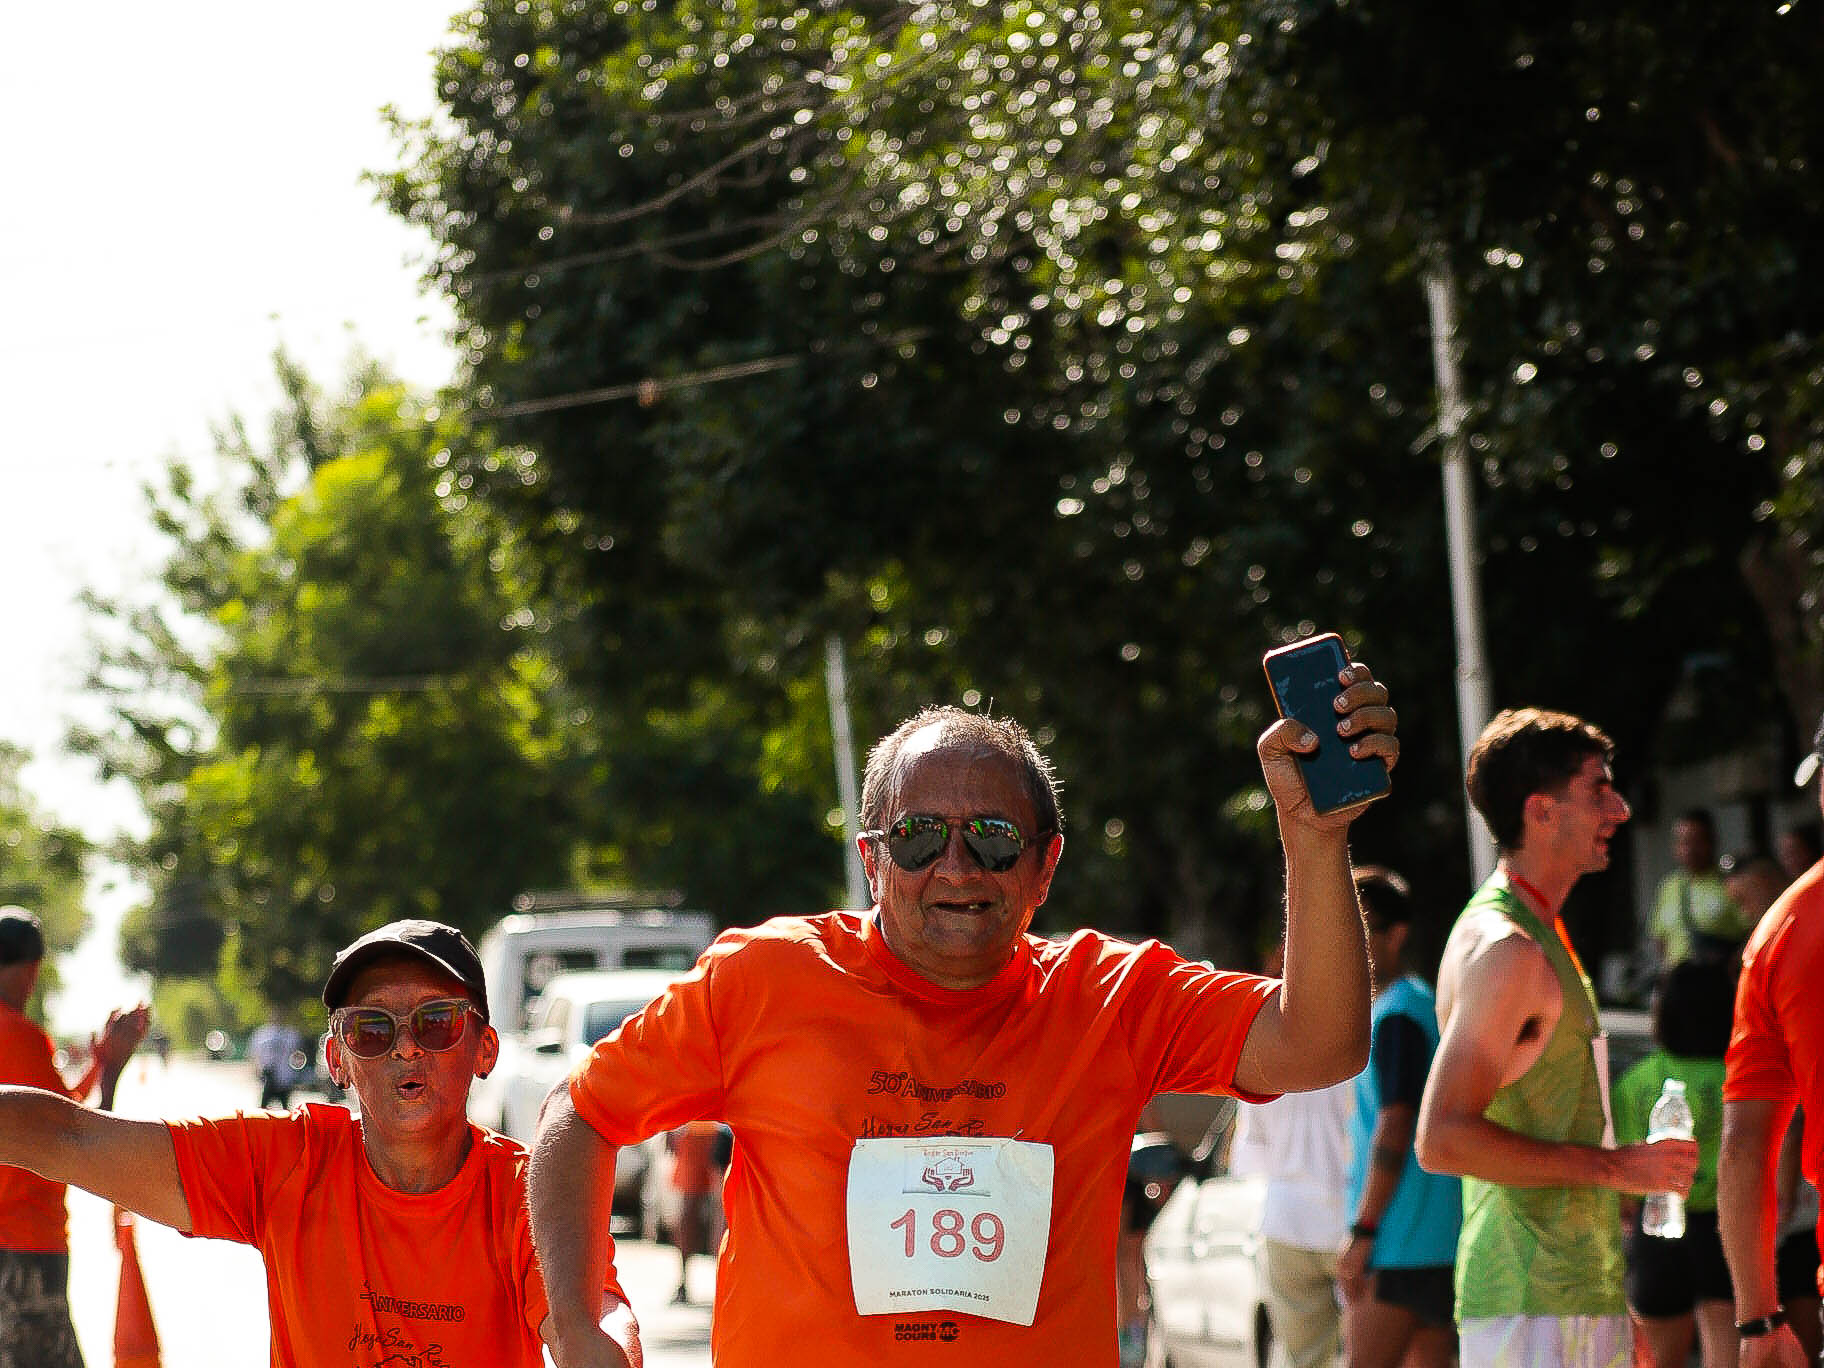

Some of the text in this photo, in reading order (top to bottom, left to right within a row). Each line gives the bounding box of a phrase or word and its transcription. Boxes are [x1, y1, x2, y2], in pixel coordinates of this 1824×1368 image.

[890, 1208, 1005, 1263] 189
[889, 1288, 928, 1298] MARATON
[930, 1288, 972, 1299] SOLIDARIA
